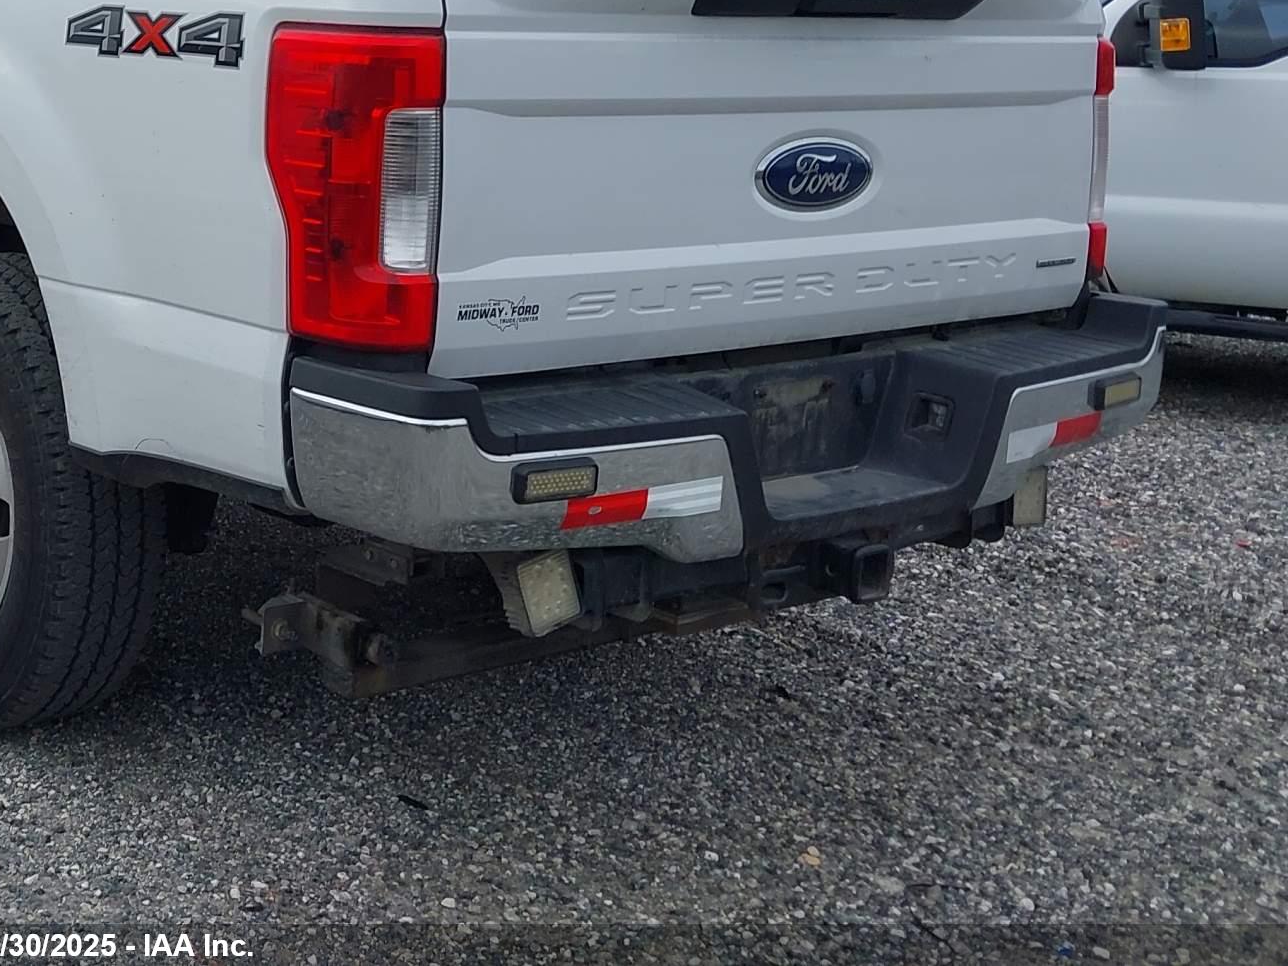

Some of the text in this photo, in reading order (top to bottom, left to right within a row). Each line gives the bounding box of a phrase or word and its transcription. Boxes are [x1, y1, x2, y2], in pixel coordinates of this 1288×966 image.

[788, 153, 851, 196] Ford
[566, 253, 1016, 321] SUPER DUTY
[457, 304, 540, 321] MIDWAY FORD
